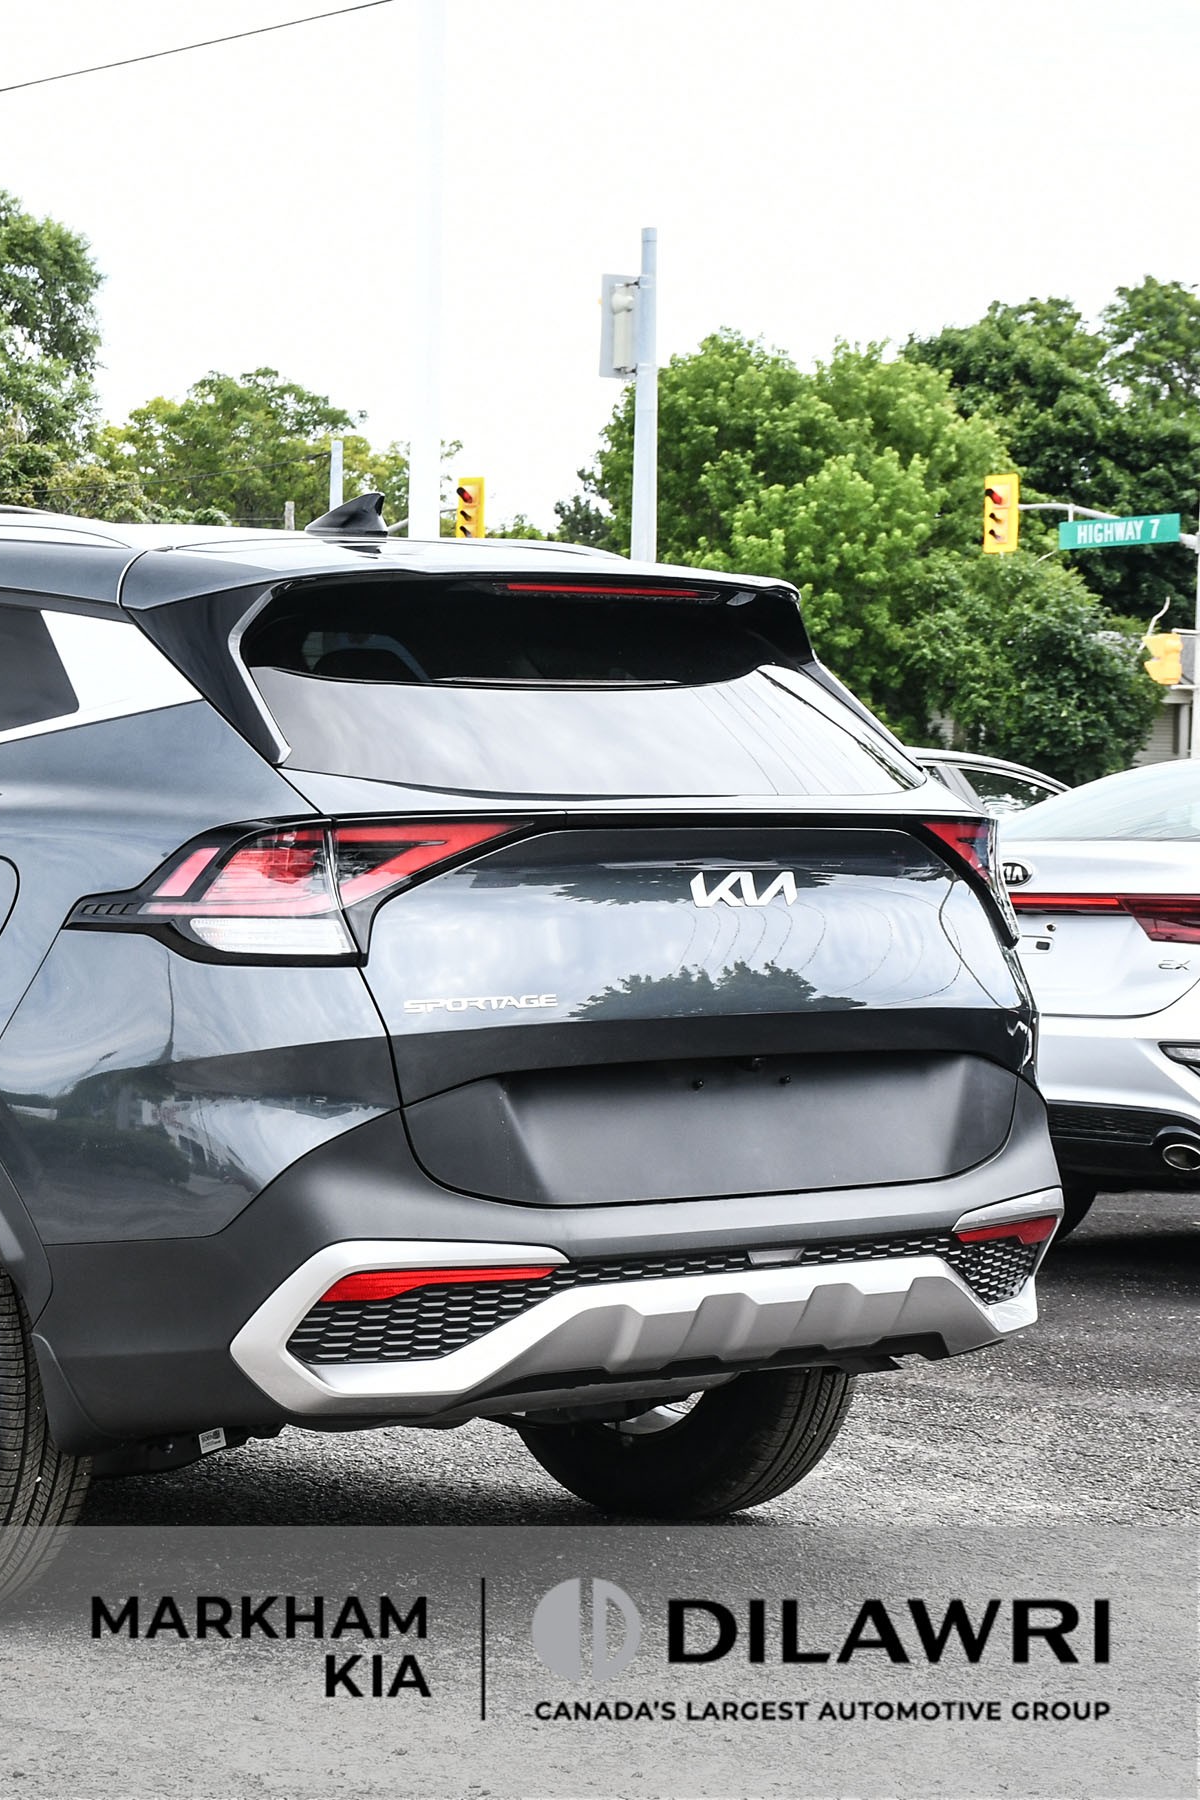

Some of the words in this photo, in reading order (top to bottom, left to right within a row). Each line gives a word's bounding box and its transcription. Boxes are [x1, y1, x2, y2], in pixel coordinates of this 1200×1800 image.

[1077, 519, 1145, 545] HIGHWAY
[1149, 518, 1161, 540] 7
[689, 870, 799, 908] KIA
[403, 993, 559, 1015] SPORTAGE
